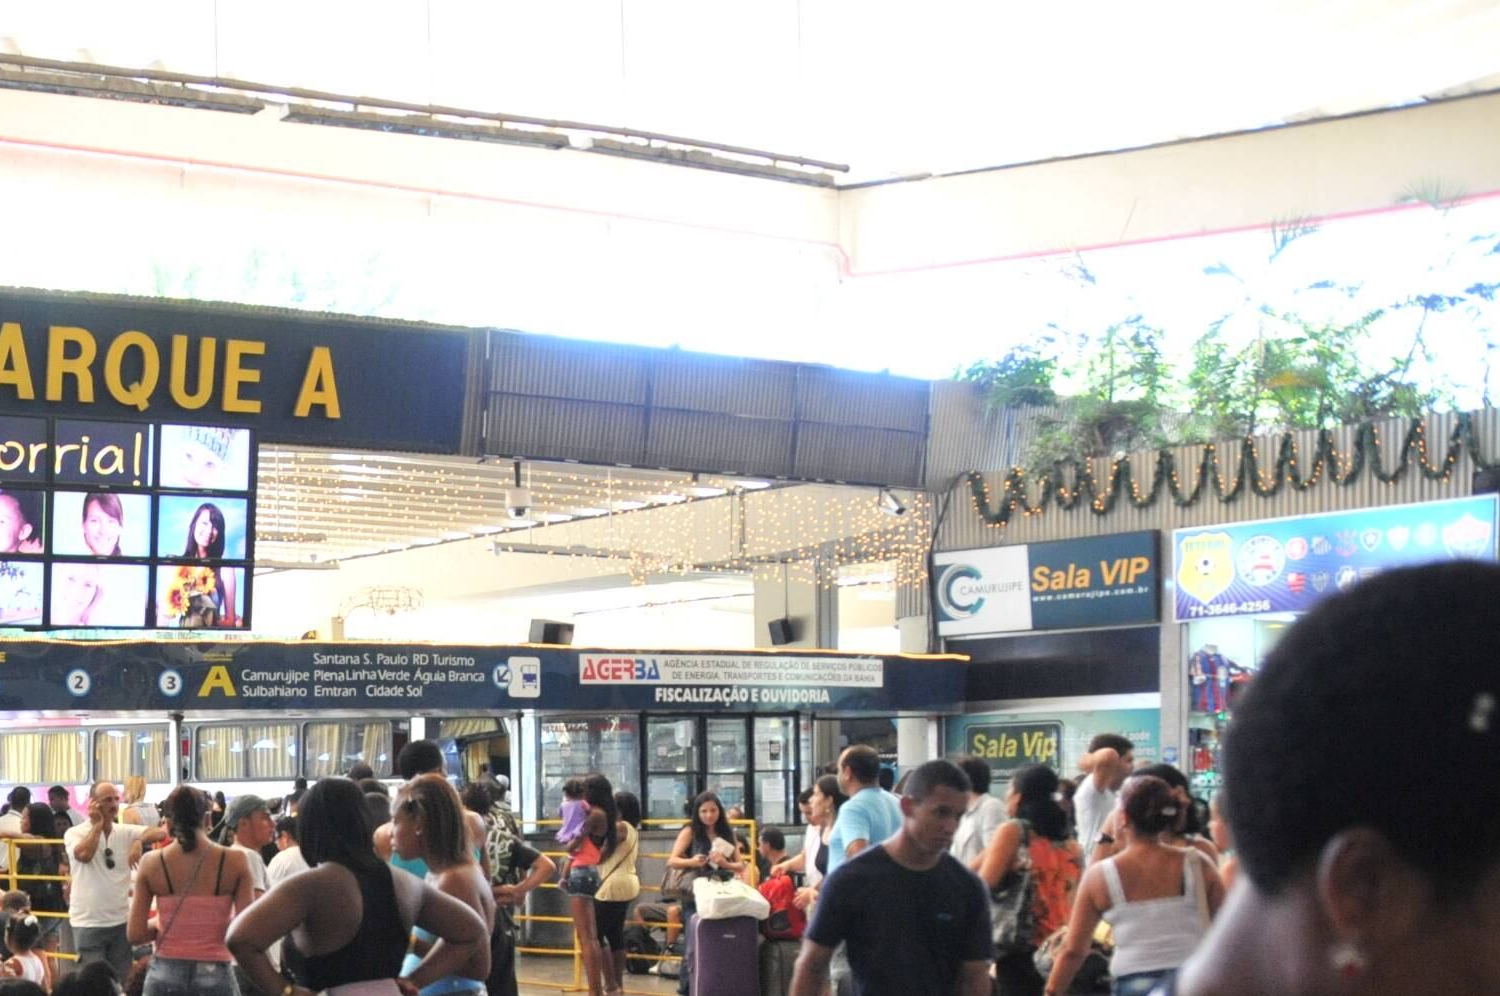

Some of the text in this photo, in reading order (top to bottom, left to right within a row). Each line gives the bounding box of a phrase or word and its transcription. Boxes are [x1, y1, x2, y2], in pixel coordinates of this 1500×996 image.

[294, 346, 342, 419] A
[1031, 556, 1150, 592] Sala VIP
[959, 581, 1025, 597] CAMURUJIPE
[313, 653, 476, 666] Santana S. Paulo RD Turismo
[581, 658, 661, 681] AGERBA
[73, 675, 84, 690] 2
[165, 676, 177, 690] 3
[197, 665, 237, 697] A
[241, 669, 310, 684] Camurujipe
[314, 670, 345, 682] Plena
[414, 667, 447, 684] Águia
[449, 670, 485, 683] Branca
[243, 685, 423, 697] Sulbahiano Emtran Cidade Sol
[655, 684, 831, 707] FISCALIZAÇÃO E OUVIDORIA
[972, 731, 1057, 763] Sala Vip
